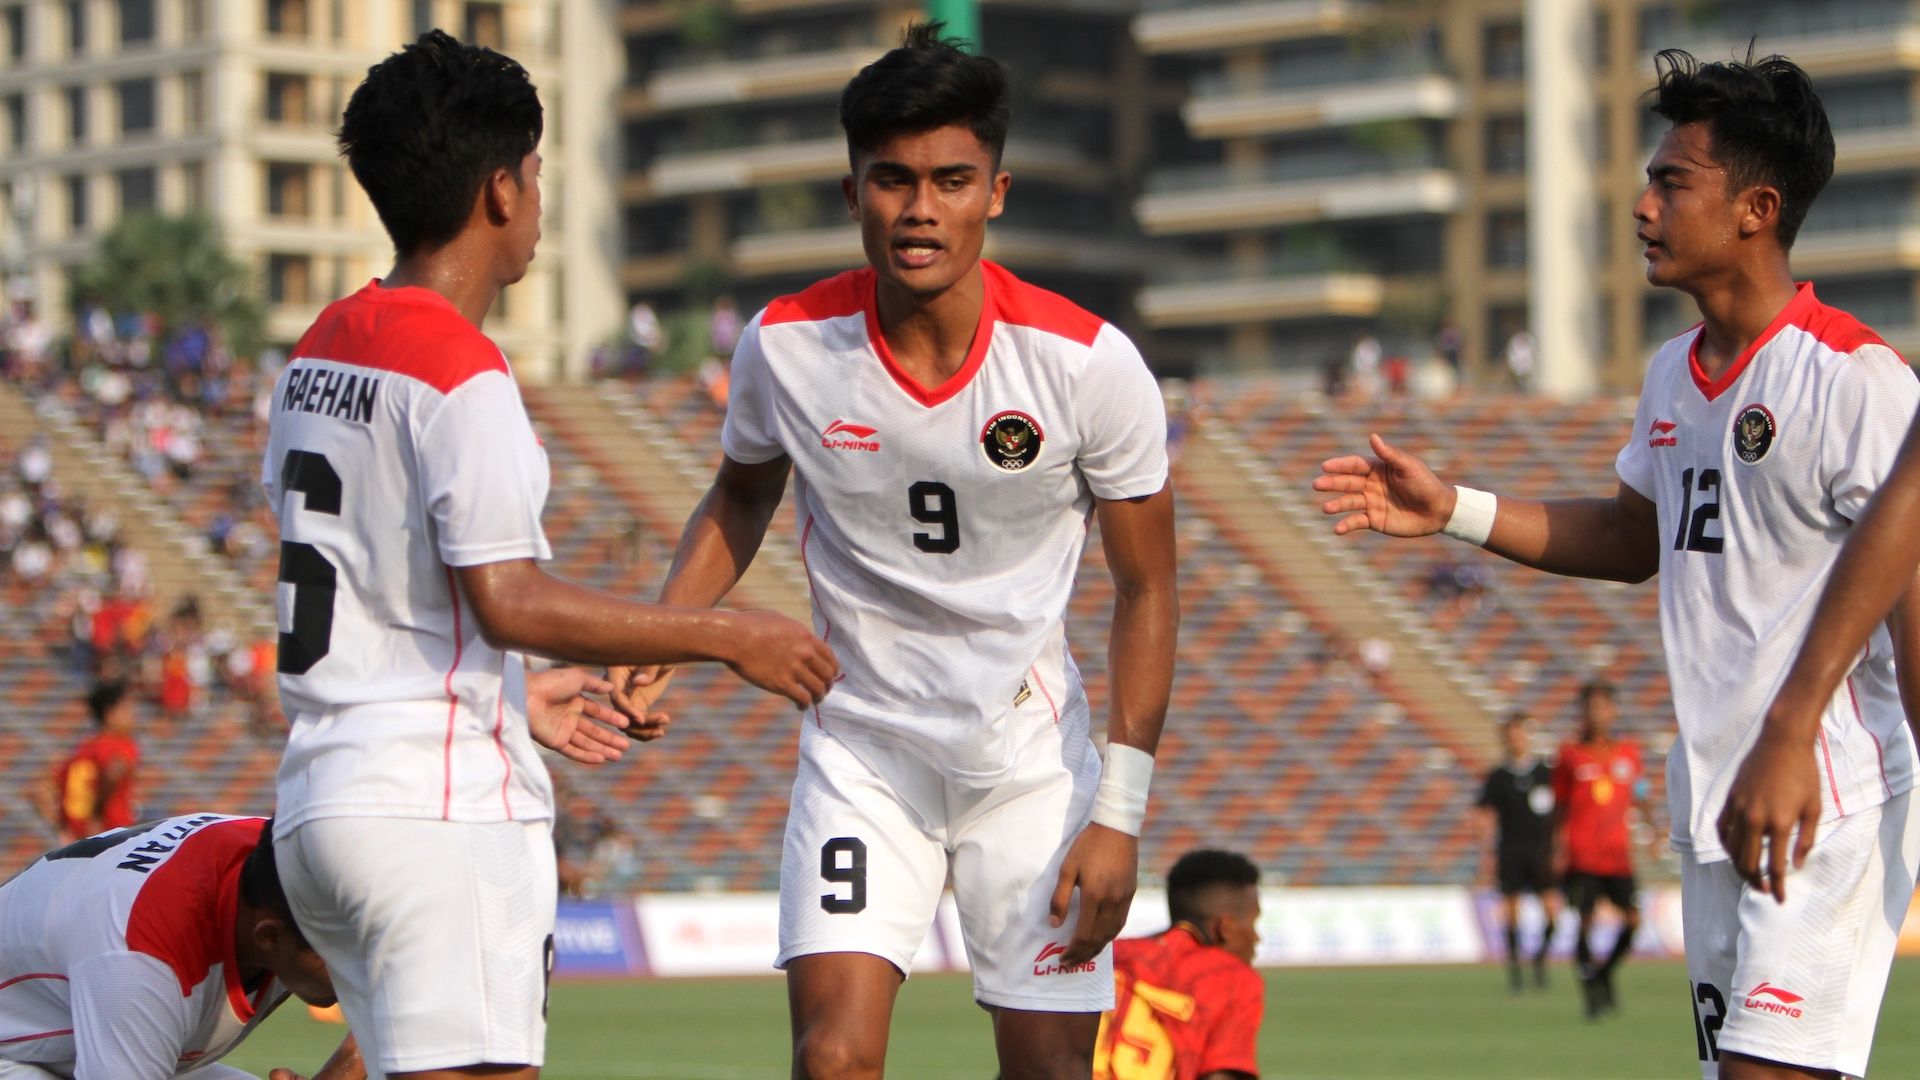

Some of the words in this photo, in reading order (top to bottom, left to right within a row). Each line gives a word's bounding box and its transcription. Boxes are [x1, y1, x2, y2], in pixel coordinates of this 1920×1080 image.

[282, 368, 380, 424] RAEHAN
[821, 437, 881, 452] LI-NING
[908, 481, 961, 555] 9
[1673, 467, 1725, 554] 12
[277, 449, 343, 676] 6
[820, 836, 868, 915] 9
[1744, 997, 1803, 1019] LI-NING
